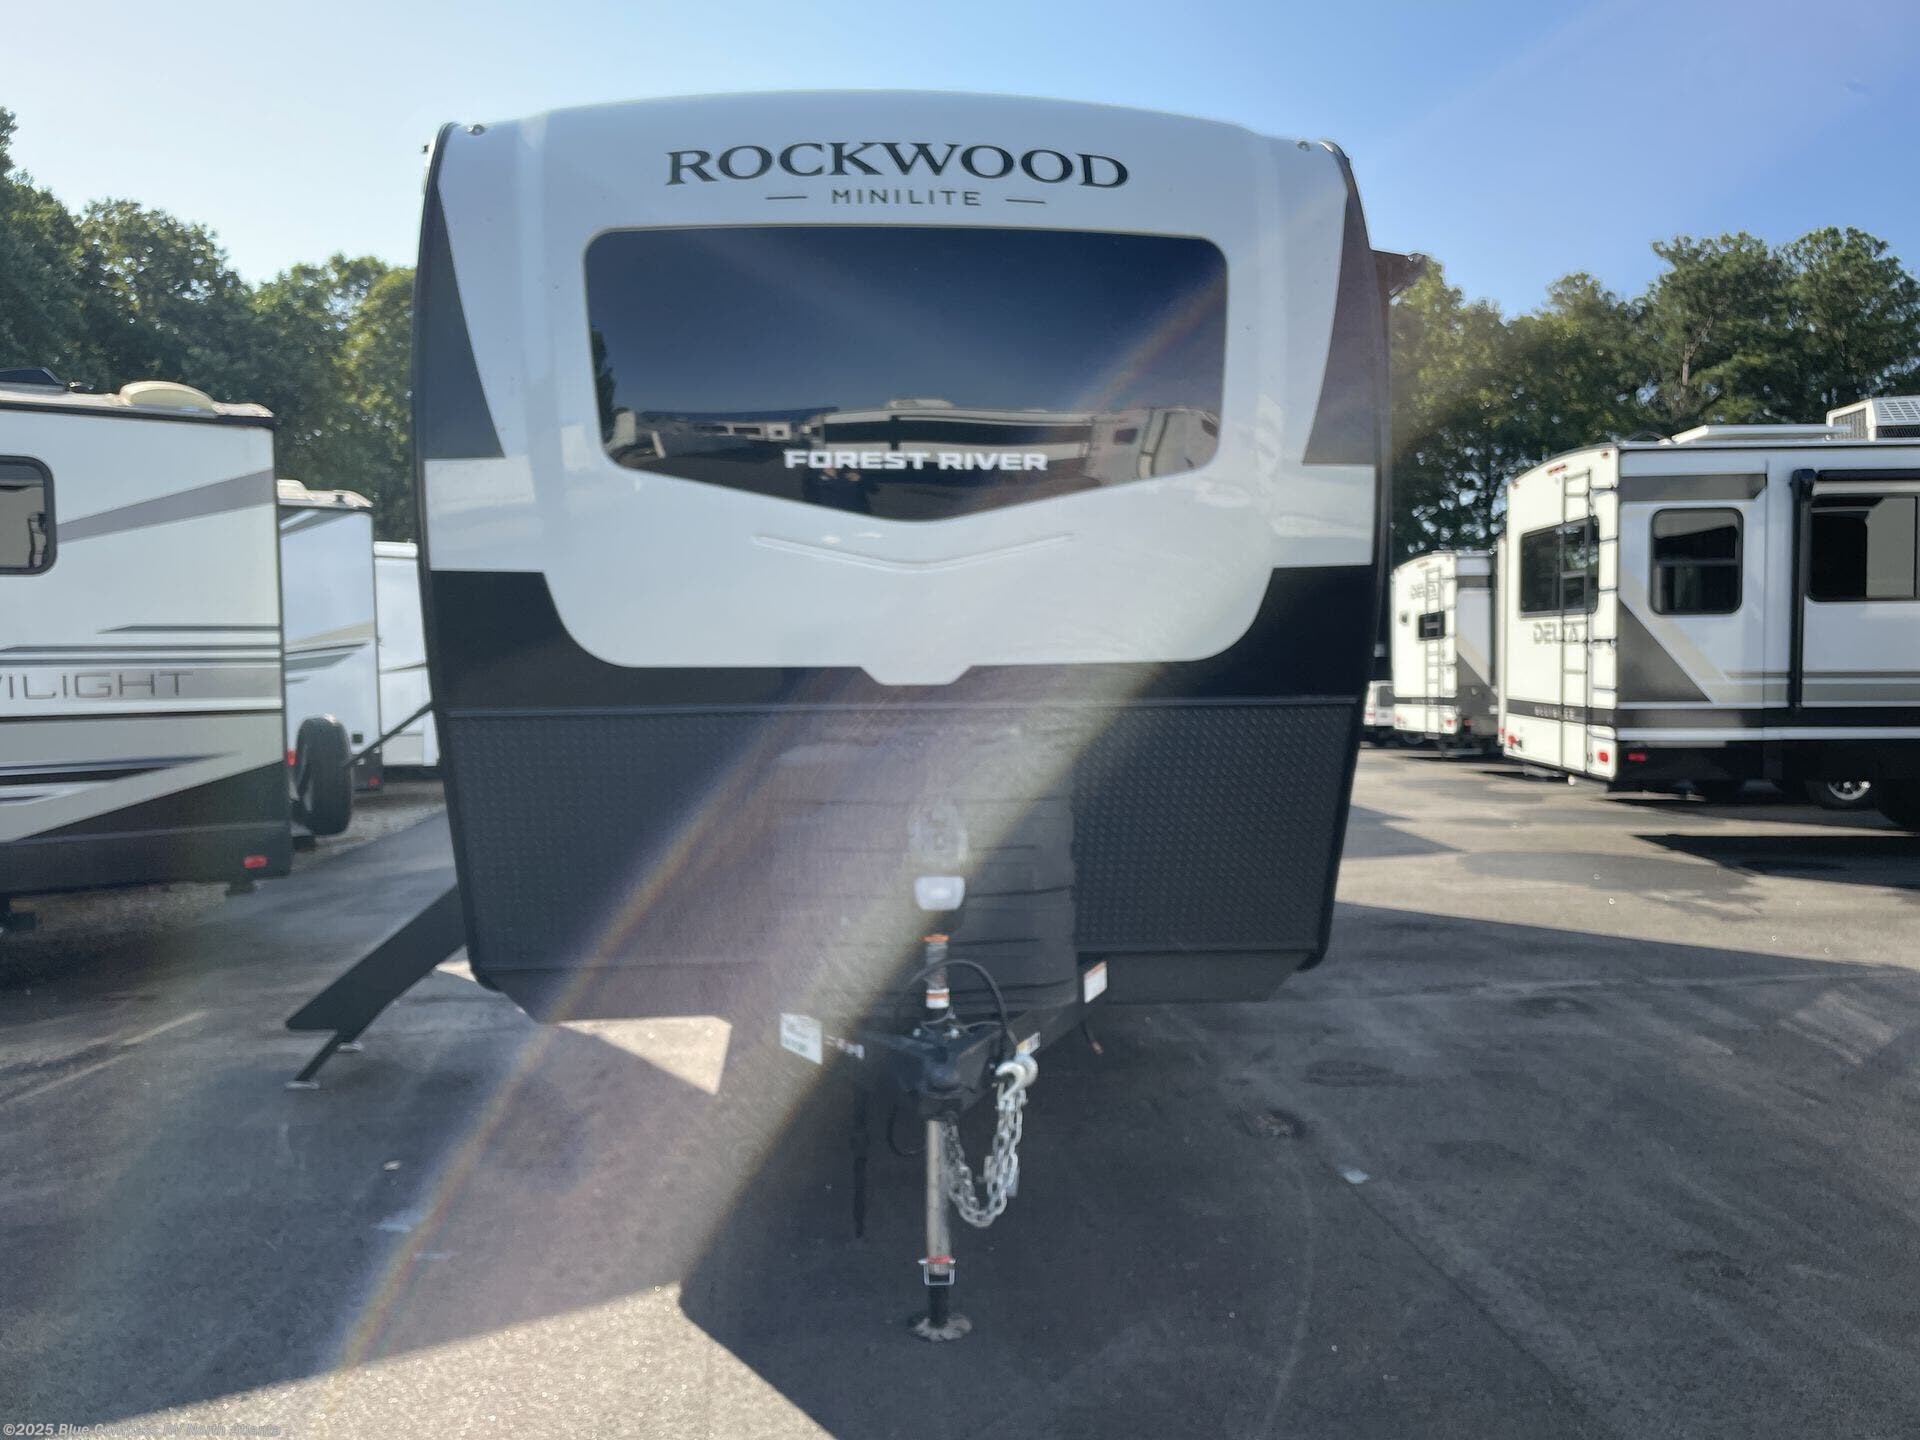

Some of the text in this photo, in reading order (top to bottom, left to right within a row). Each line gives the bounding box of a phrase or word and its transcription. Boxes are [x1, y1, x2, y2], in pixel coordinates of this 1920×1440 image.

[665, 141, 1129, 188] ROCKWOOD
[831, 189, 981, 206] MINILITE
[783, 449, 1049, 471] FOREST RIVER
[0, 671, 194, 700] ILIGHT
